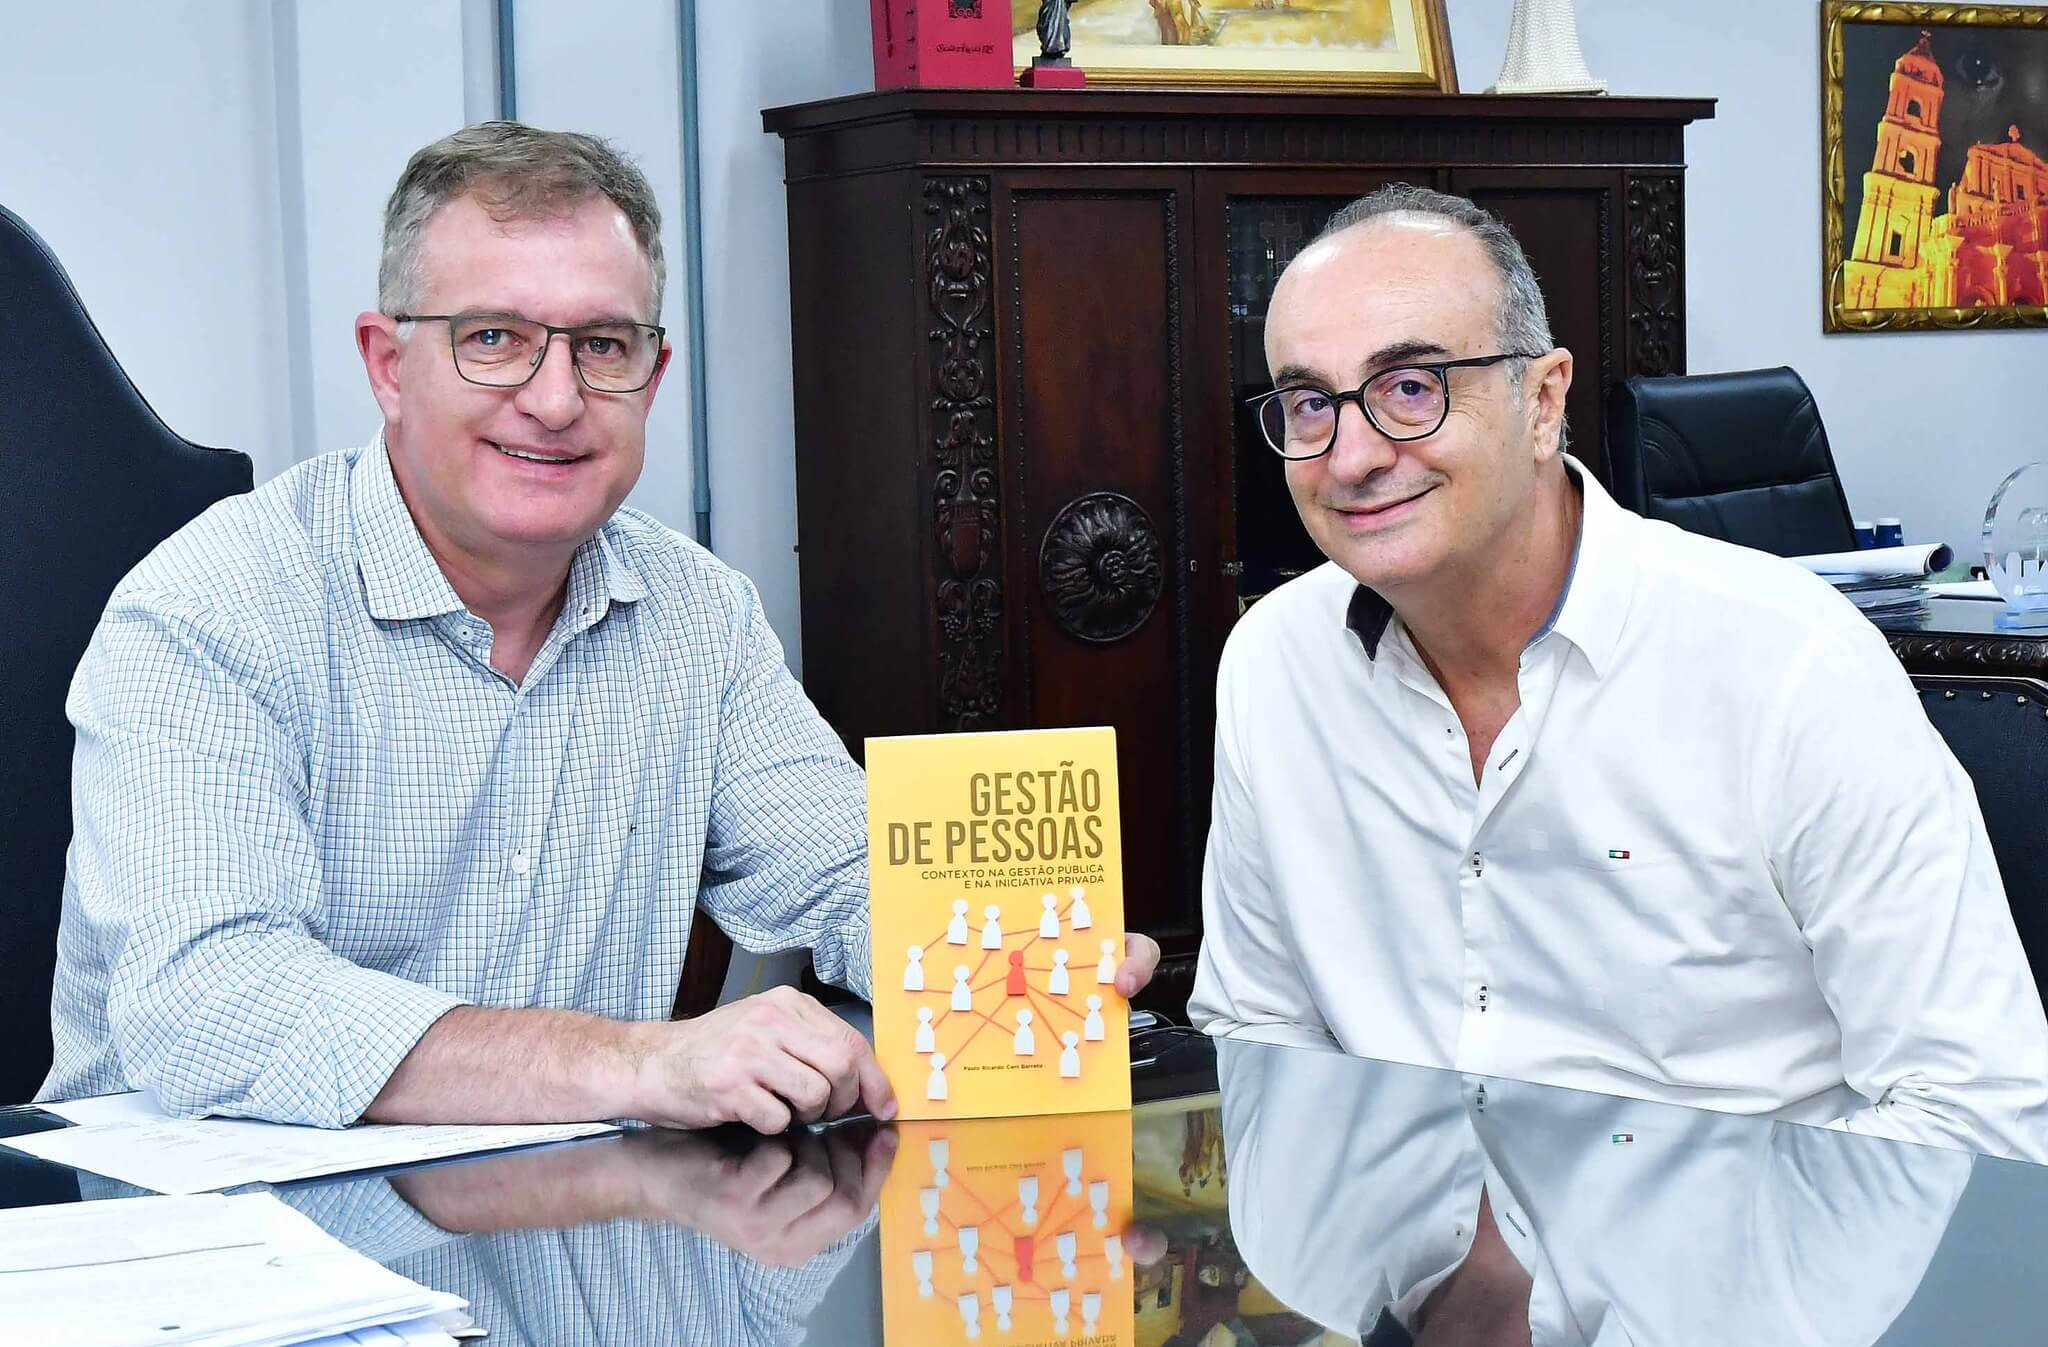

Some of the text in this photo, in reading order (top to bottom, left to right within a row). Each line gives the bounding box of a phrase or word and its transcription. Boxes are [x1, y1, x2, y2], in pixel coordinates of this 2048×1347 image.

[970, 760, 1101, 816] GESTÃO
[888, 815, 1103, 865] DE PESSOAS
[921, 863, 1104, 880] CONTEXTO NA GESTÃO PÚBLICA
[964, 874, 1105, 889] E NA INICIATIVA PRIVADA
